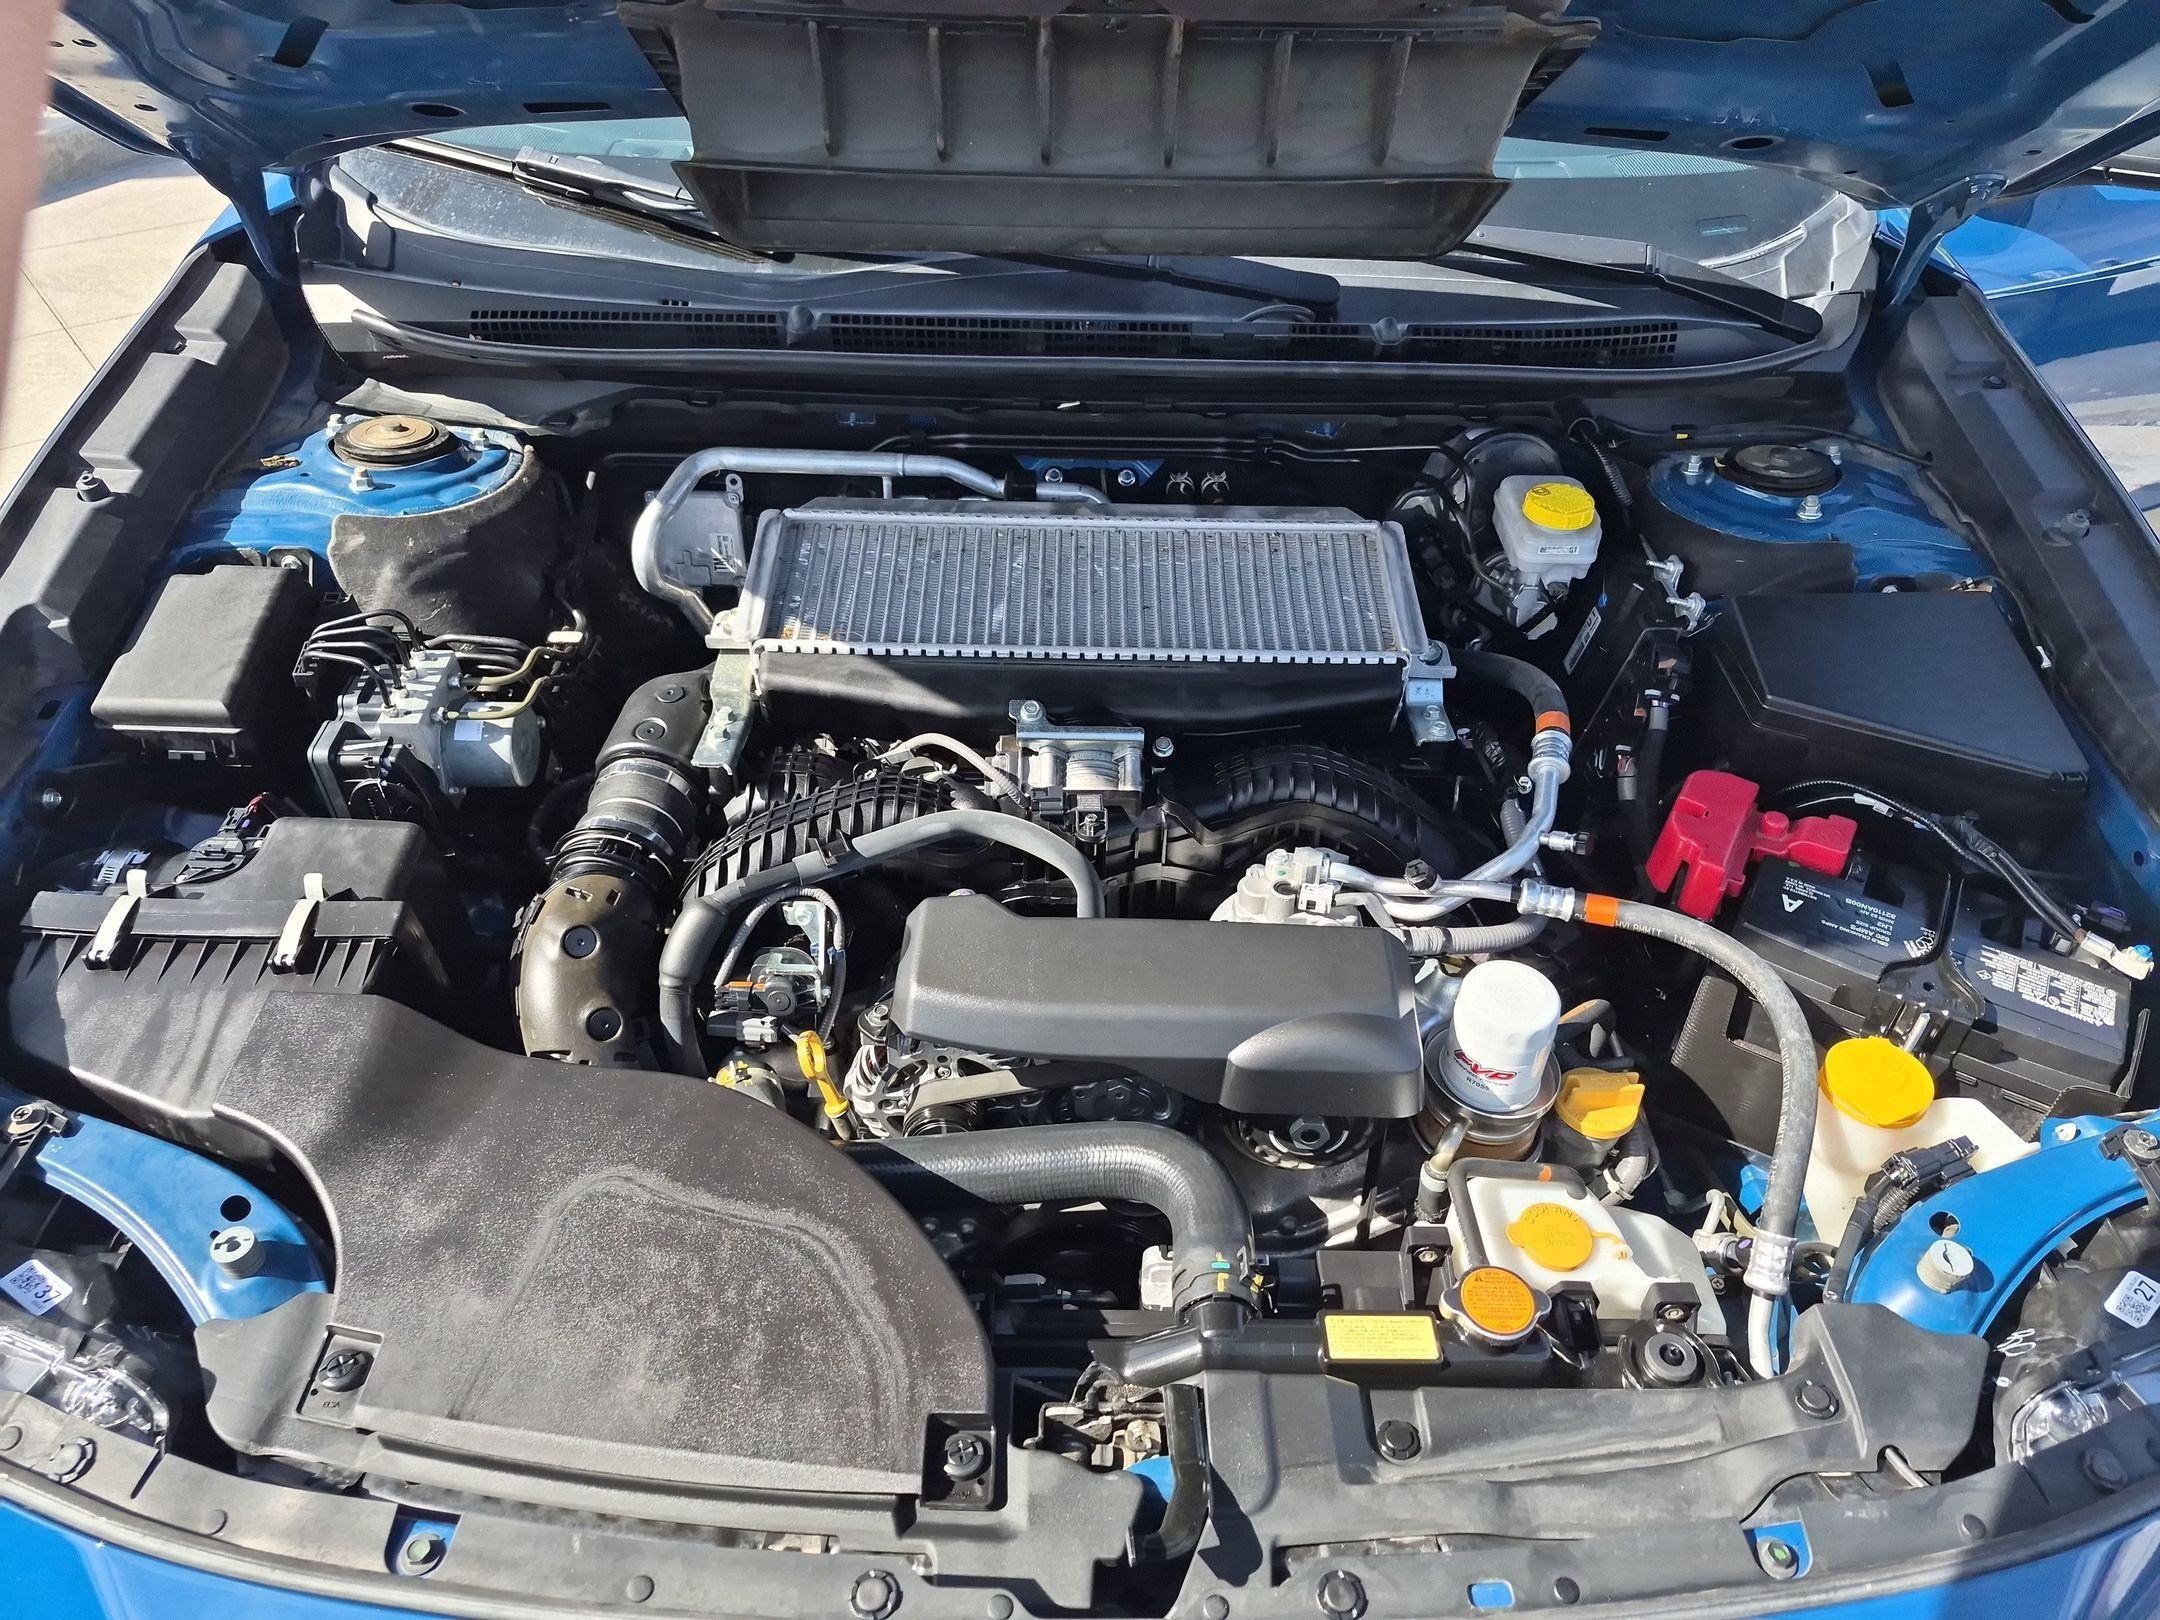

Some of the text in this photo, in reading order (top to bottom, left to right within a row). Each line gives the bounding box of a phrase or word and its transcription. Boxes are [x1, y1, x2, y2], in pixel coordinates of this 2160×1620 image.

[1781, 893, 1804, 913] A
[1820, 918, 1838, 929] AMPS
[1849, 923, 1874, 936] AMPS
[1876, 920, 1893, 930] LN2
[34, 1285, 61, 1303] 37
[2133, 1280, 2157, 1302] 27
